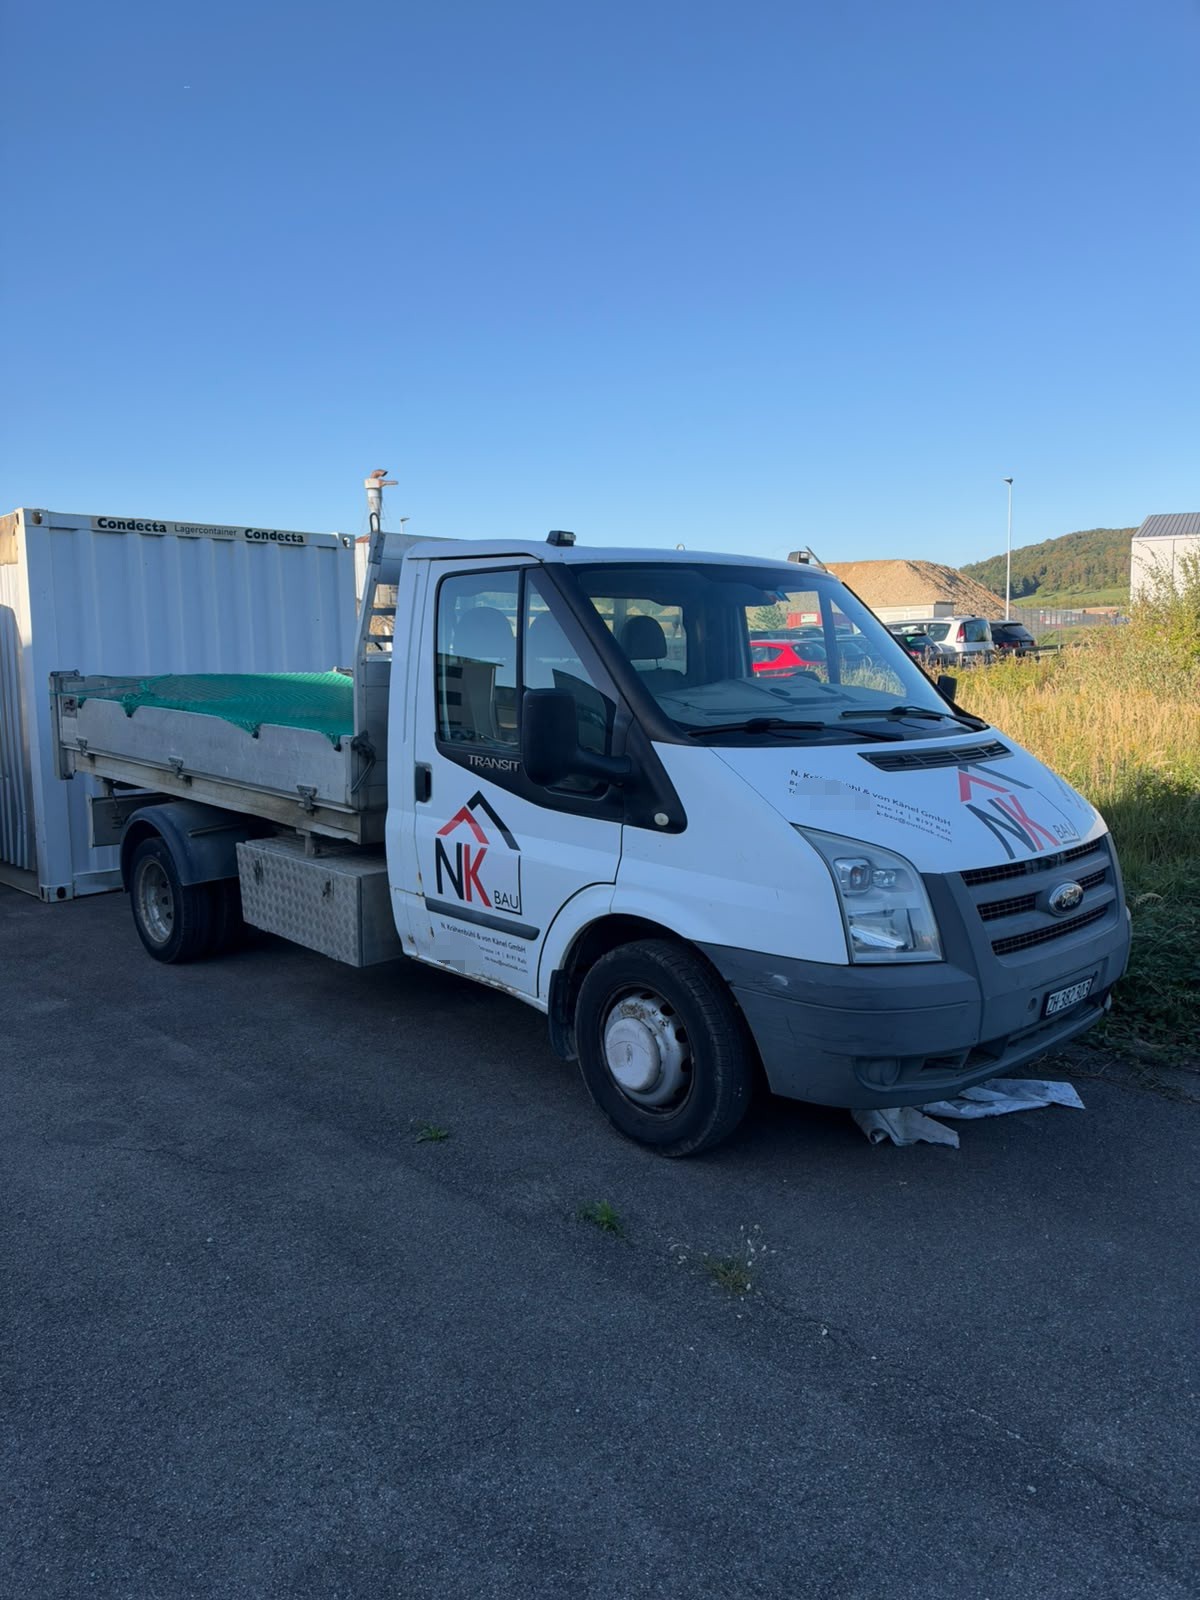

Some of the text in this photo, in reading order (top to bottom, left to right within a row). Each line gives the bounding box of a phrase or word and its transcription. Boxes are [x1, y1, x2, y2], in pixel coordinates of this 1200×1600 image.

[97, 517, 304, 543] Condecta Lagercontainer Condecta
[468, 754, 521, 772] TRANSIT
[790, 769, 801, 778] N.
[872, 792, 890, 803] von
[892, 798, 919, 814] Känel
[920, 810, 951, 827] GmbH
[876, 810, 953, 843] k-bau@outlook.com
[965, 794, 1061, 860] NK
[1052, 822, 1076, 839] BAU
[435, 837, 493, 908] NK
[494, 890, 519, 910] BAU
[507, 942, 527, 954] GmbH
